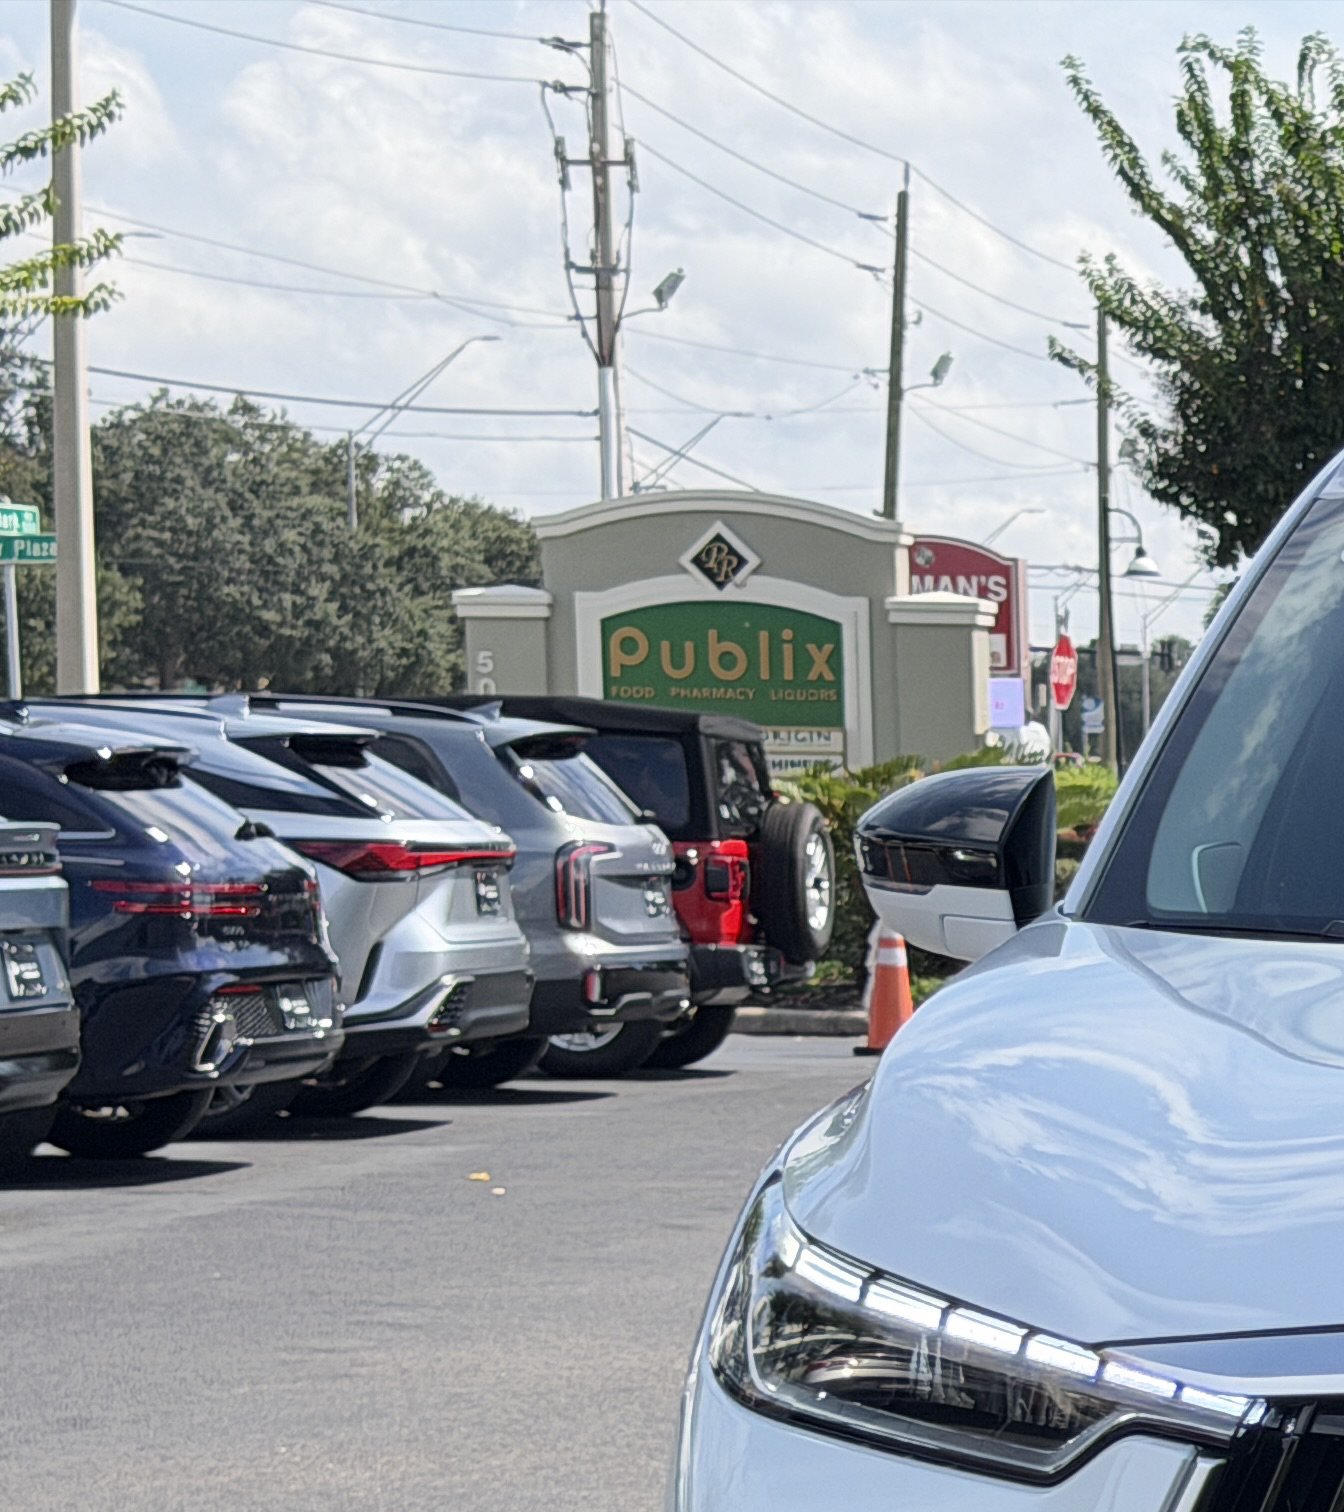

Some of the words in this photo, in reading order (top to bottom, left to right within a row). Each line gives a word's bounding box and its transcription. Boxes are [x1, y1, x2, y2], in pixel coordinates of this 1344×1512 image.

[609, 626, 835, 681] Publix
[609, 685, 656, 699] FOOD
[669, 686, 756, 700] PHARMACY
[769, 688, 838, 701] LIQUORS
